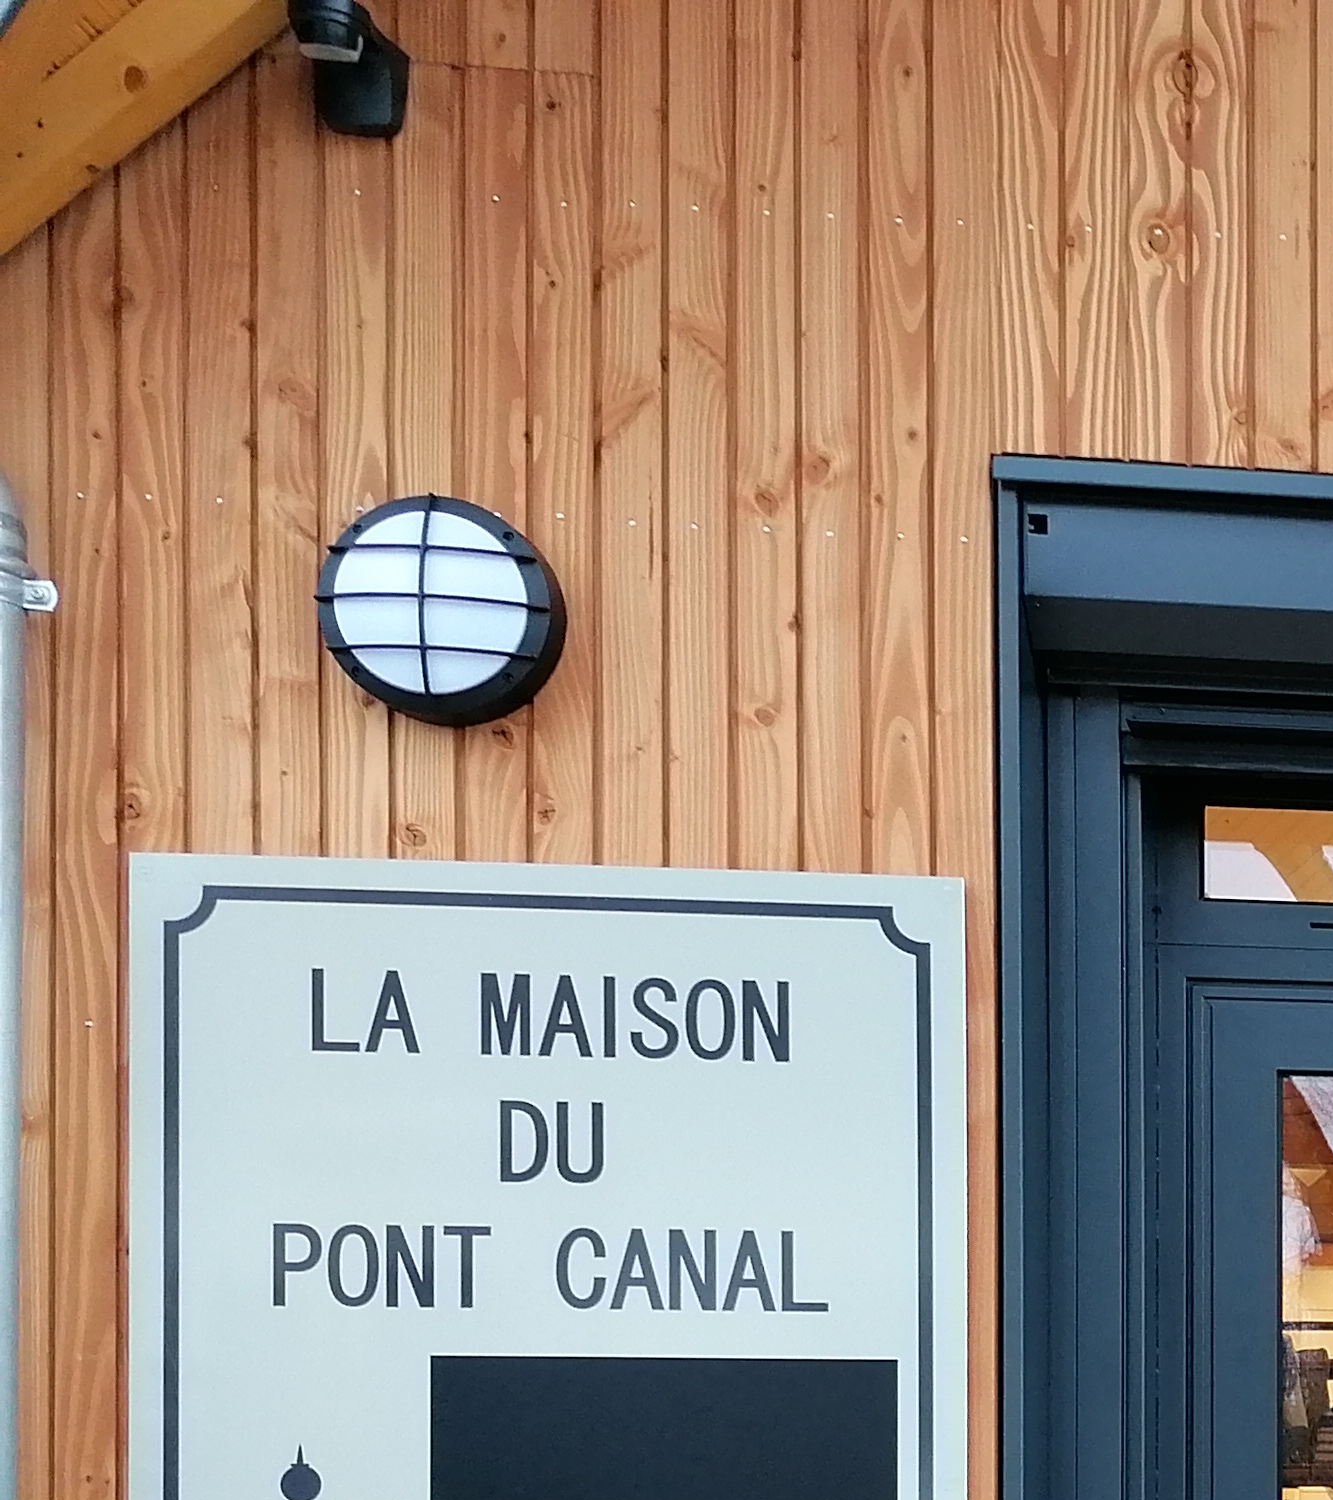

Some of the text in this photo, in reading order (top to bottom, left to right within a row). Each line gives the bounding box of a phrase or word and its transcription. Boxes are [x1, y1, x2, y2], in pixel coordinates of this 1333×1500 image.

[311, 967, 791, 1063] LA MAISON
[498, 1098, 606, 1185] DU
[271, 1222, 830, 1313] PONT CANAL
